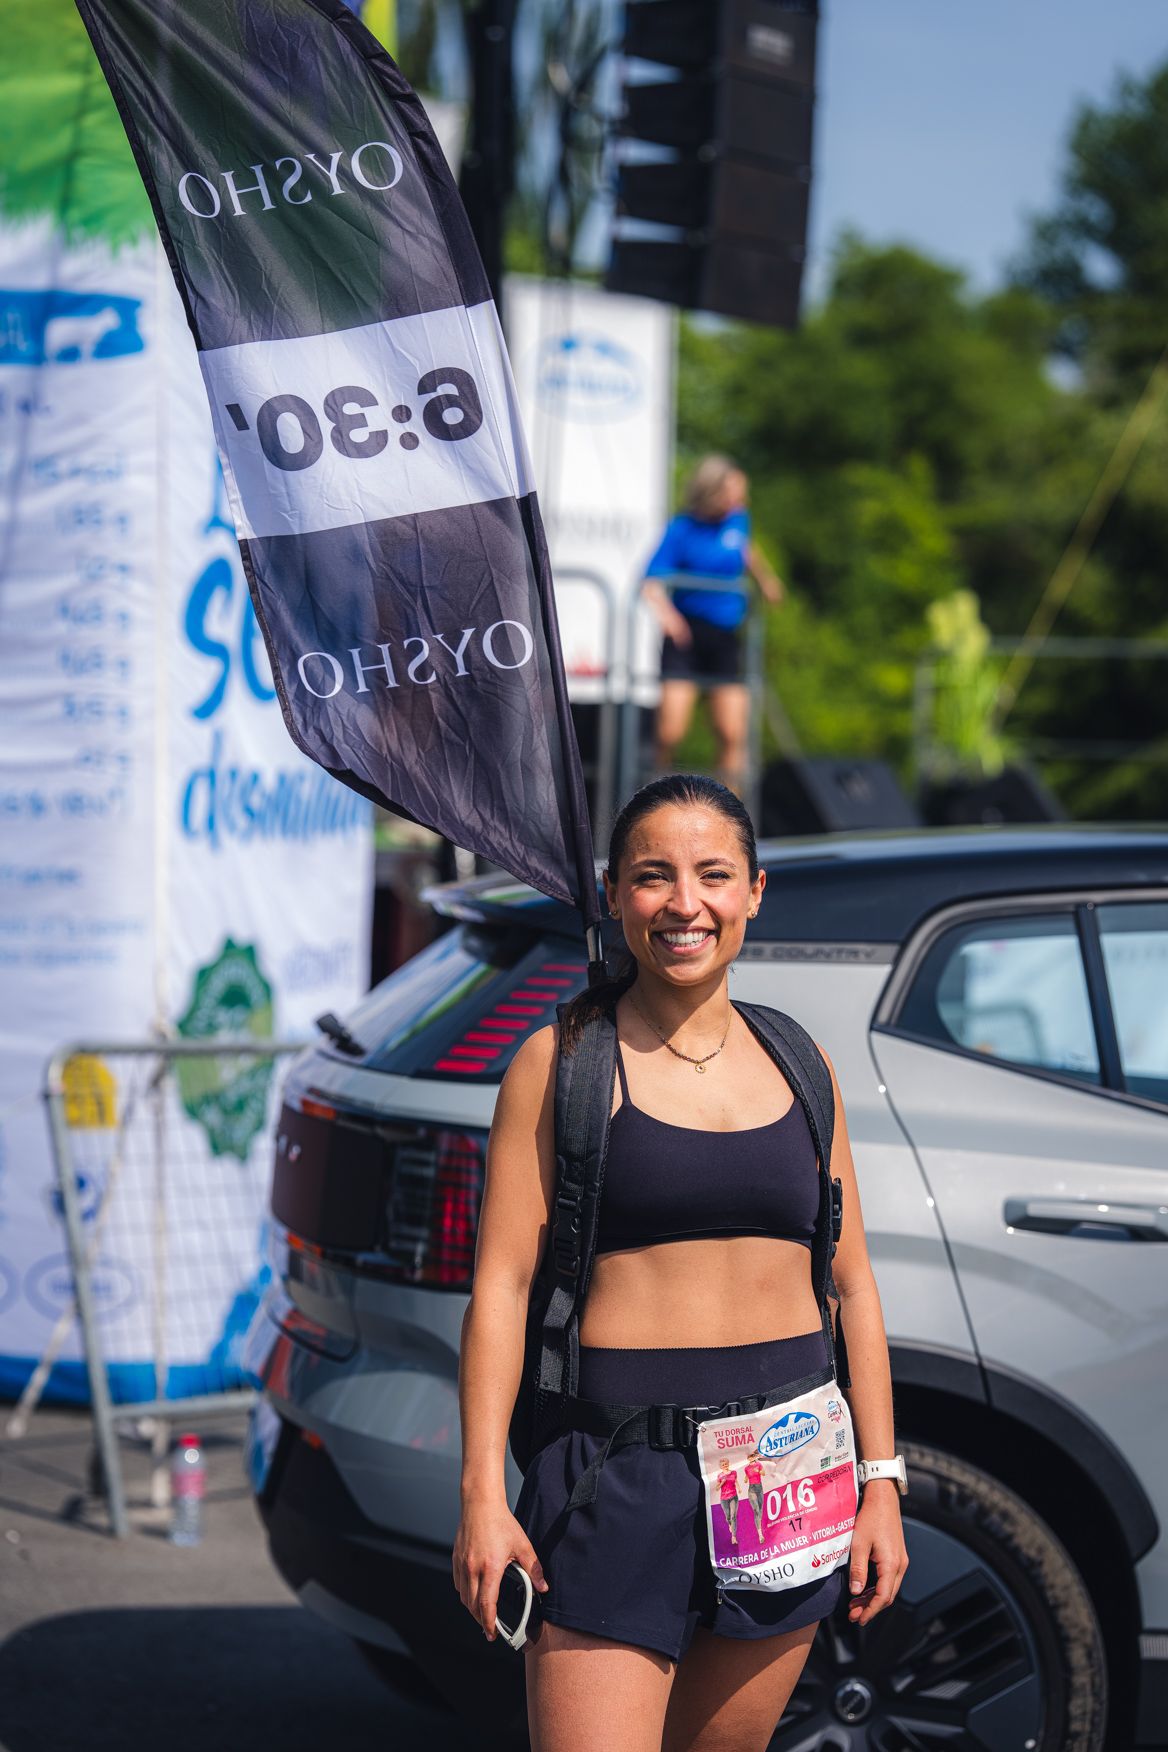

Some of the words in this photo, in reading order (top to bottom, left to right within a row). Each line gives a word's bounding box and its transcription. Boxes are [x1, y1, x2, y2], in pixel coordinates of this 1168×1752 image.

[770, 946, 877, 960] COUNTRY
[713, 1431, 724, 1439] TU
[725, 1425, 754, 1437] DORSAL
[716, 1433, 755, 1449] SUMA
[765, 1424, 815, 1453] ASTURIANA
[766, 1477, 816, 1521] 016
[788, 1517, 803, 1532] 17
[719, 1552, 760, 1567] CARRERA
[760, 1548, 769, 1560] DE
[769, 1544, 781, 1556] LA
[780, 1535, 809, 1552] MUJER
[738, 1562, 795, 1585] OYSHO
